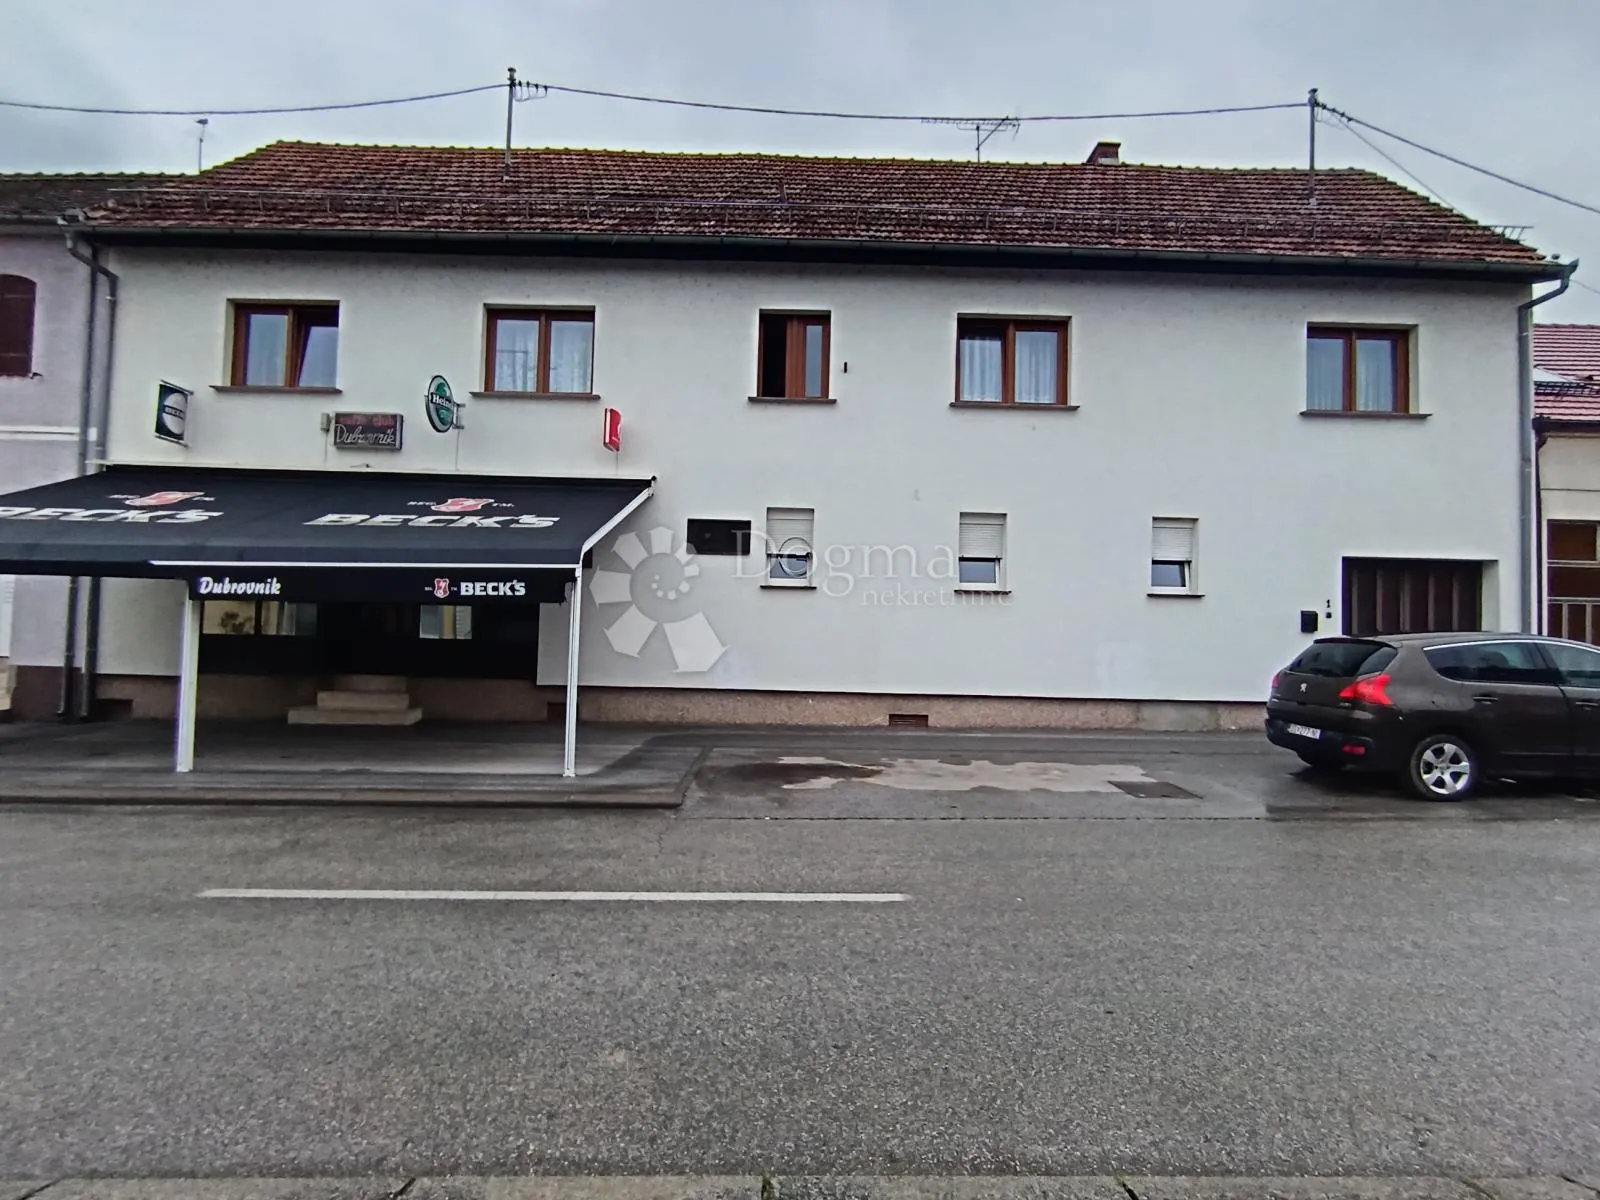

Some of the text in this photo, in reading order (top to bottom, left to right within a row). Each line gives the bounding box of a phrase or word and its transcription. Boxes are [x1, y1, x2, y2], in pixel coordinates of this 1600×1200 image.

[303, 513, 561, 528] BECK'S
[199, 576, 281, 595] Dubrovnik
[460, 579, 526, 596] BECK'S
